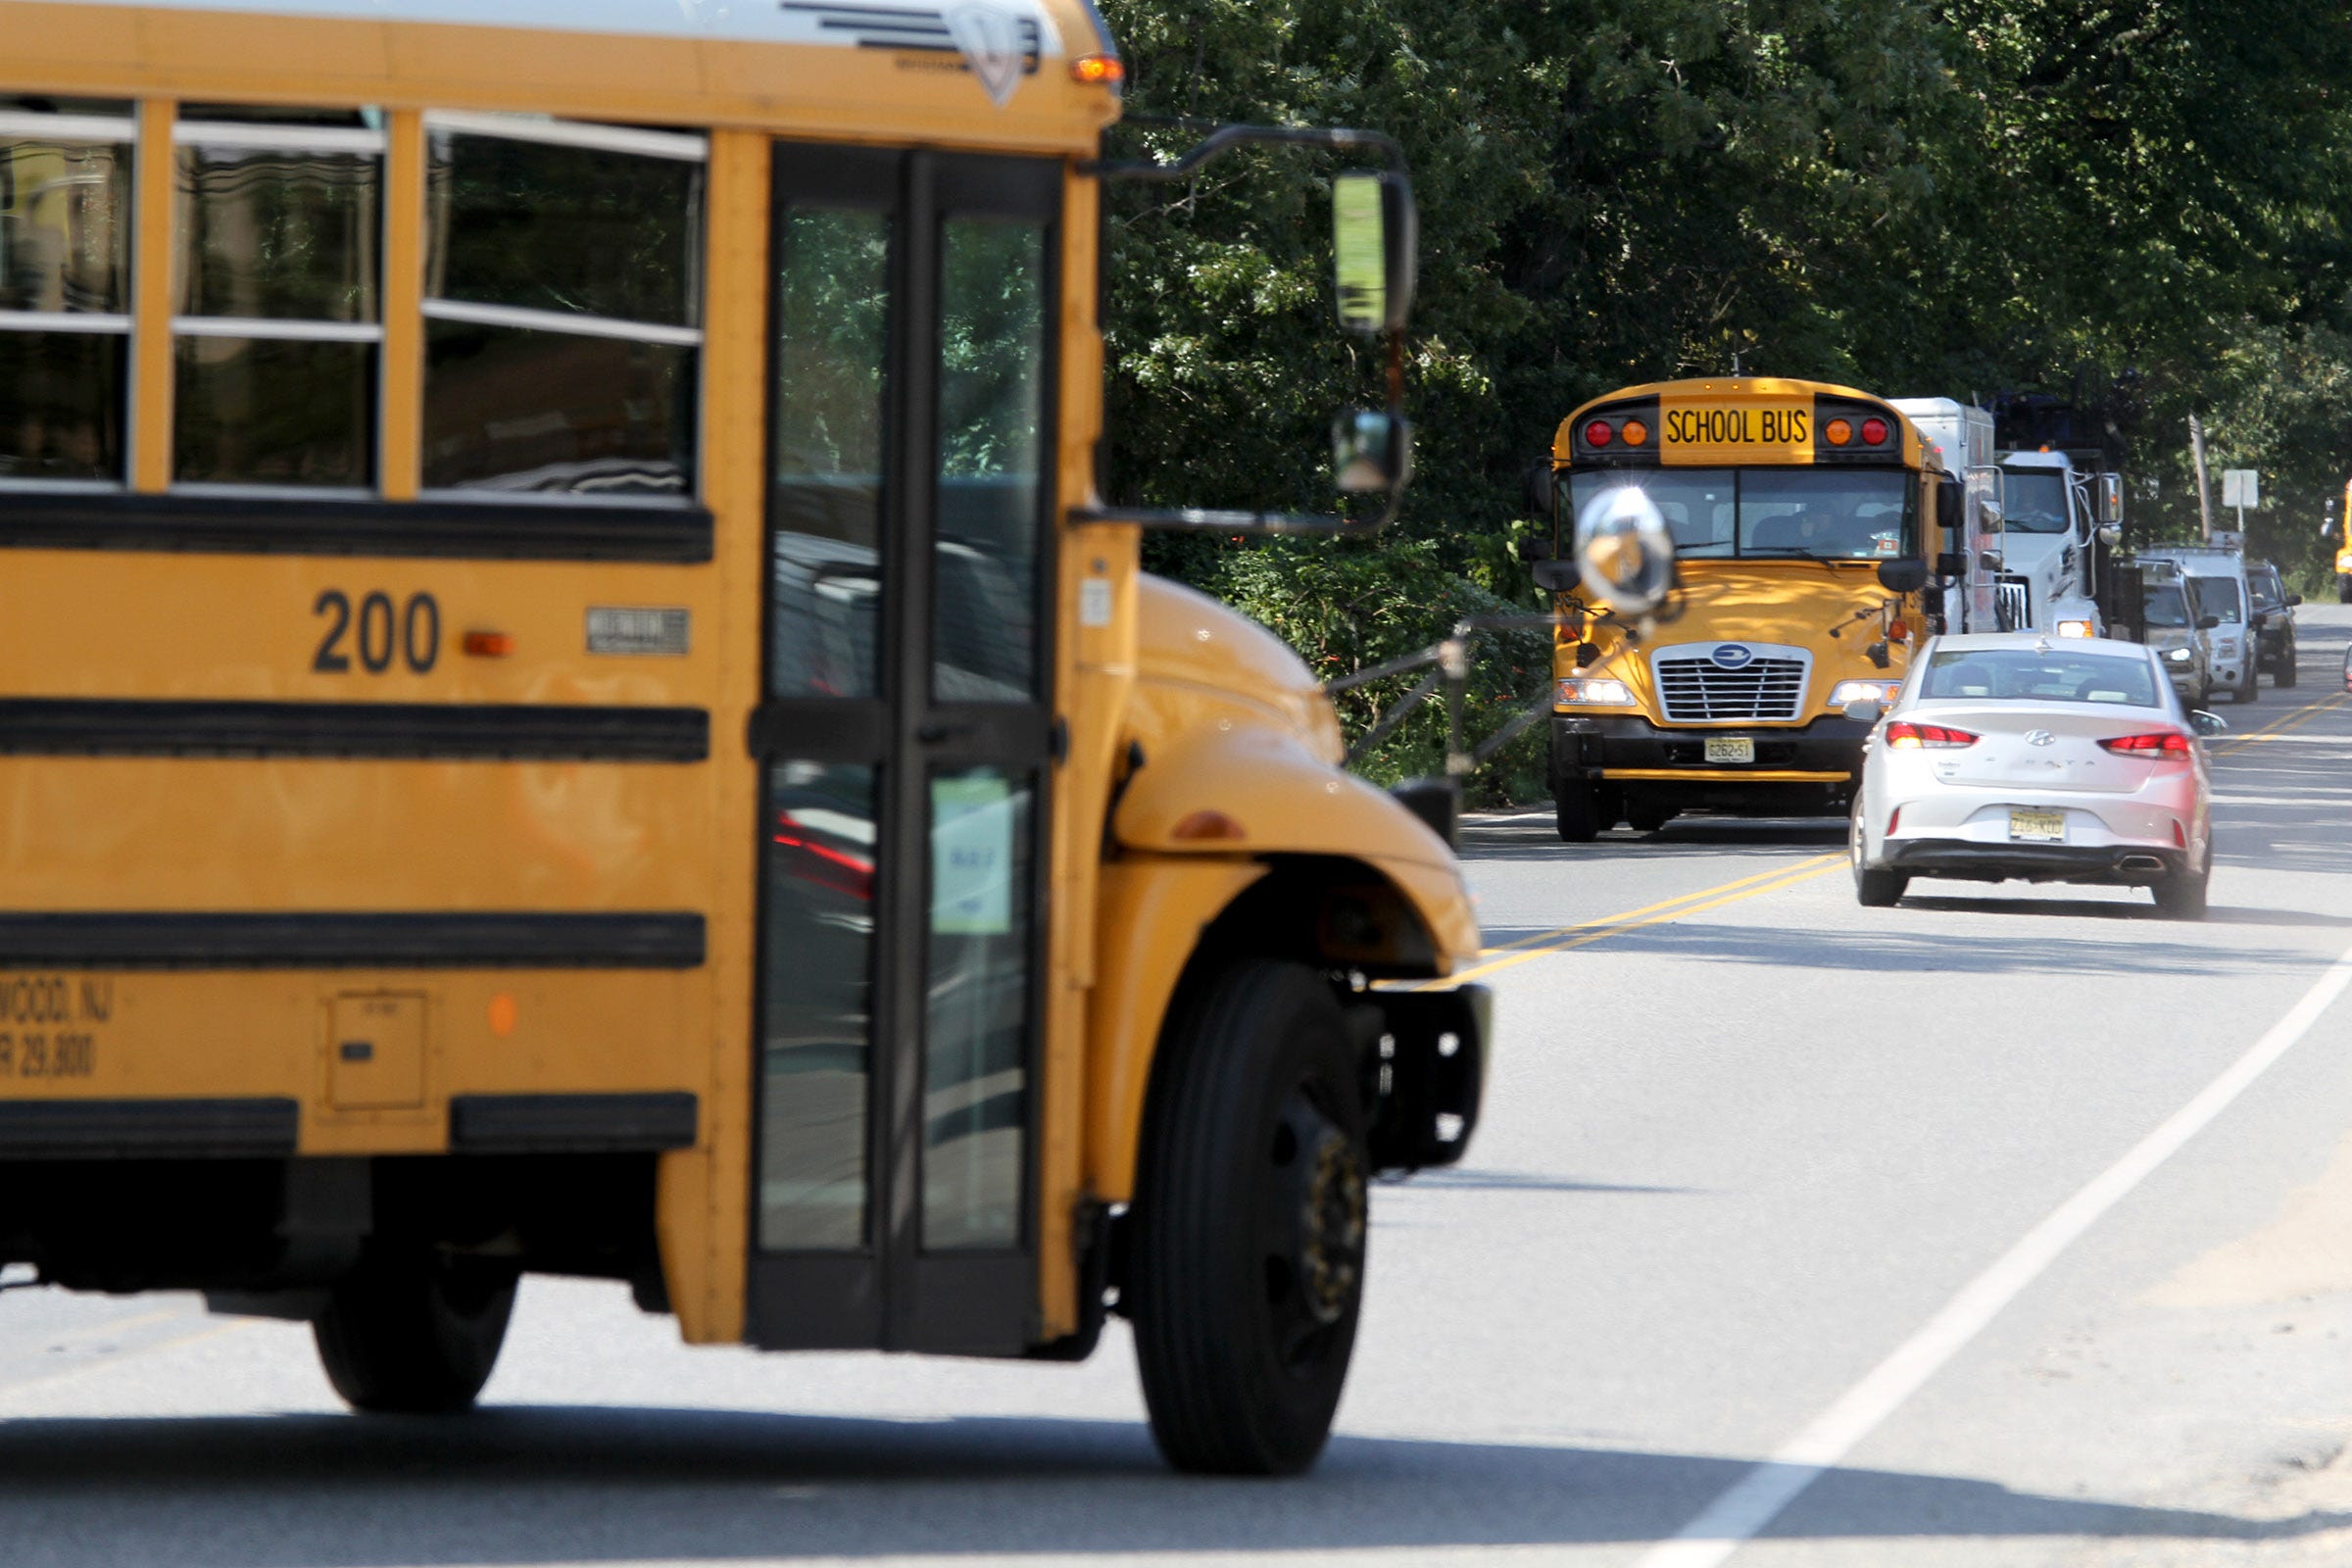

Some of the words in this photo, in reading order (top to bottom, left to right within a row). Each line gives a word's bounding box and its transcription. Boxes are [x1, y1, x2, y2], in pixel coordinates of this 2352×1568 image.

[1667, 410, 1755, 443] SCHOOL
[1762, 410, 1807, 443] BUS
[313, 590, 440, 674] 200
